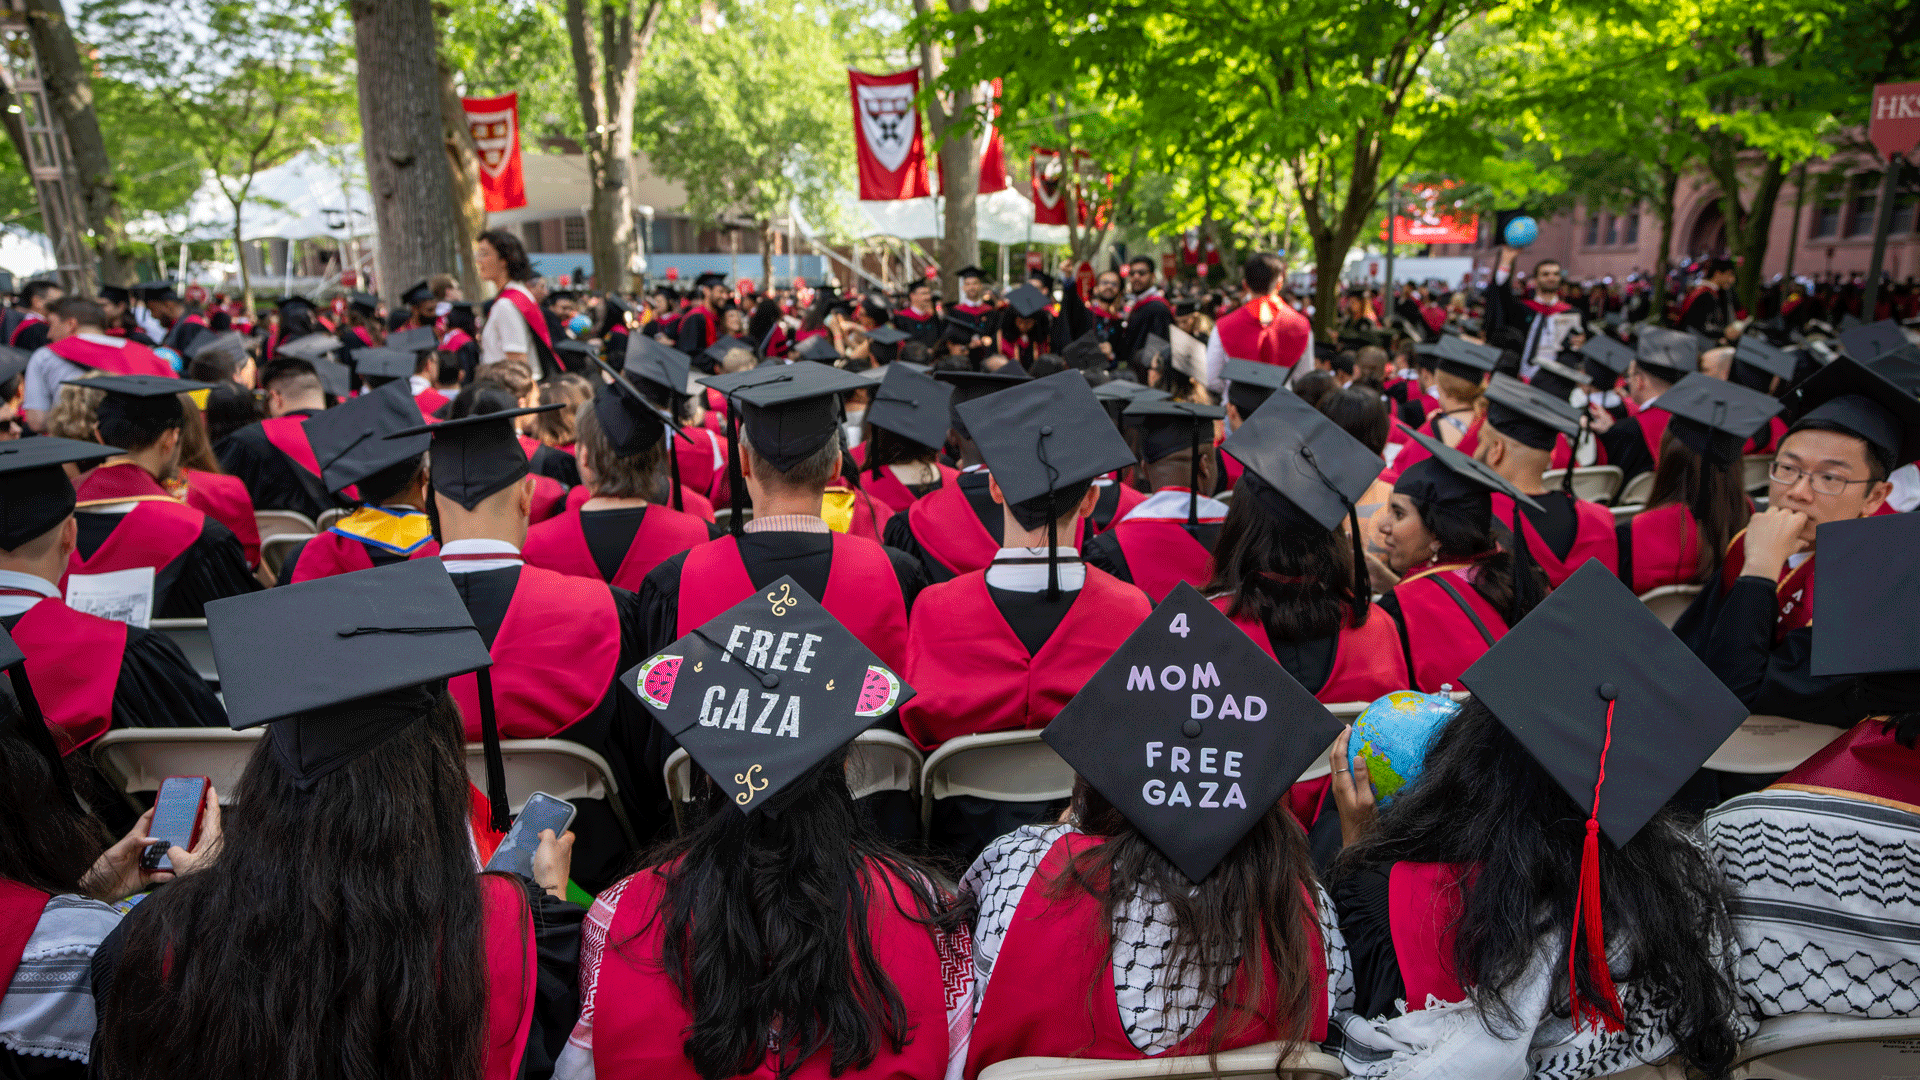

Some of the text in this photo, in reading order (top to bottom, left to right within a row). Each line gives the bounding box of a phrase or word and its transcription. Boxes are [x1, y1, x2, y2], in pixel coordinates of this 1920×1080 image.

[1169, 613, 1191, 638] 4
[720, 624, 823, 674] FREE
[1126, 661, 1221, 692] MOM
[698, 685, 801, 738] GAZA
[1191, 693, 1268, 722] DAD
[1146, 741, 1244, 778] FREE
[1142, 779, 1247, 810] GAZA
